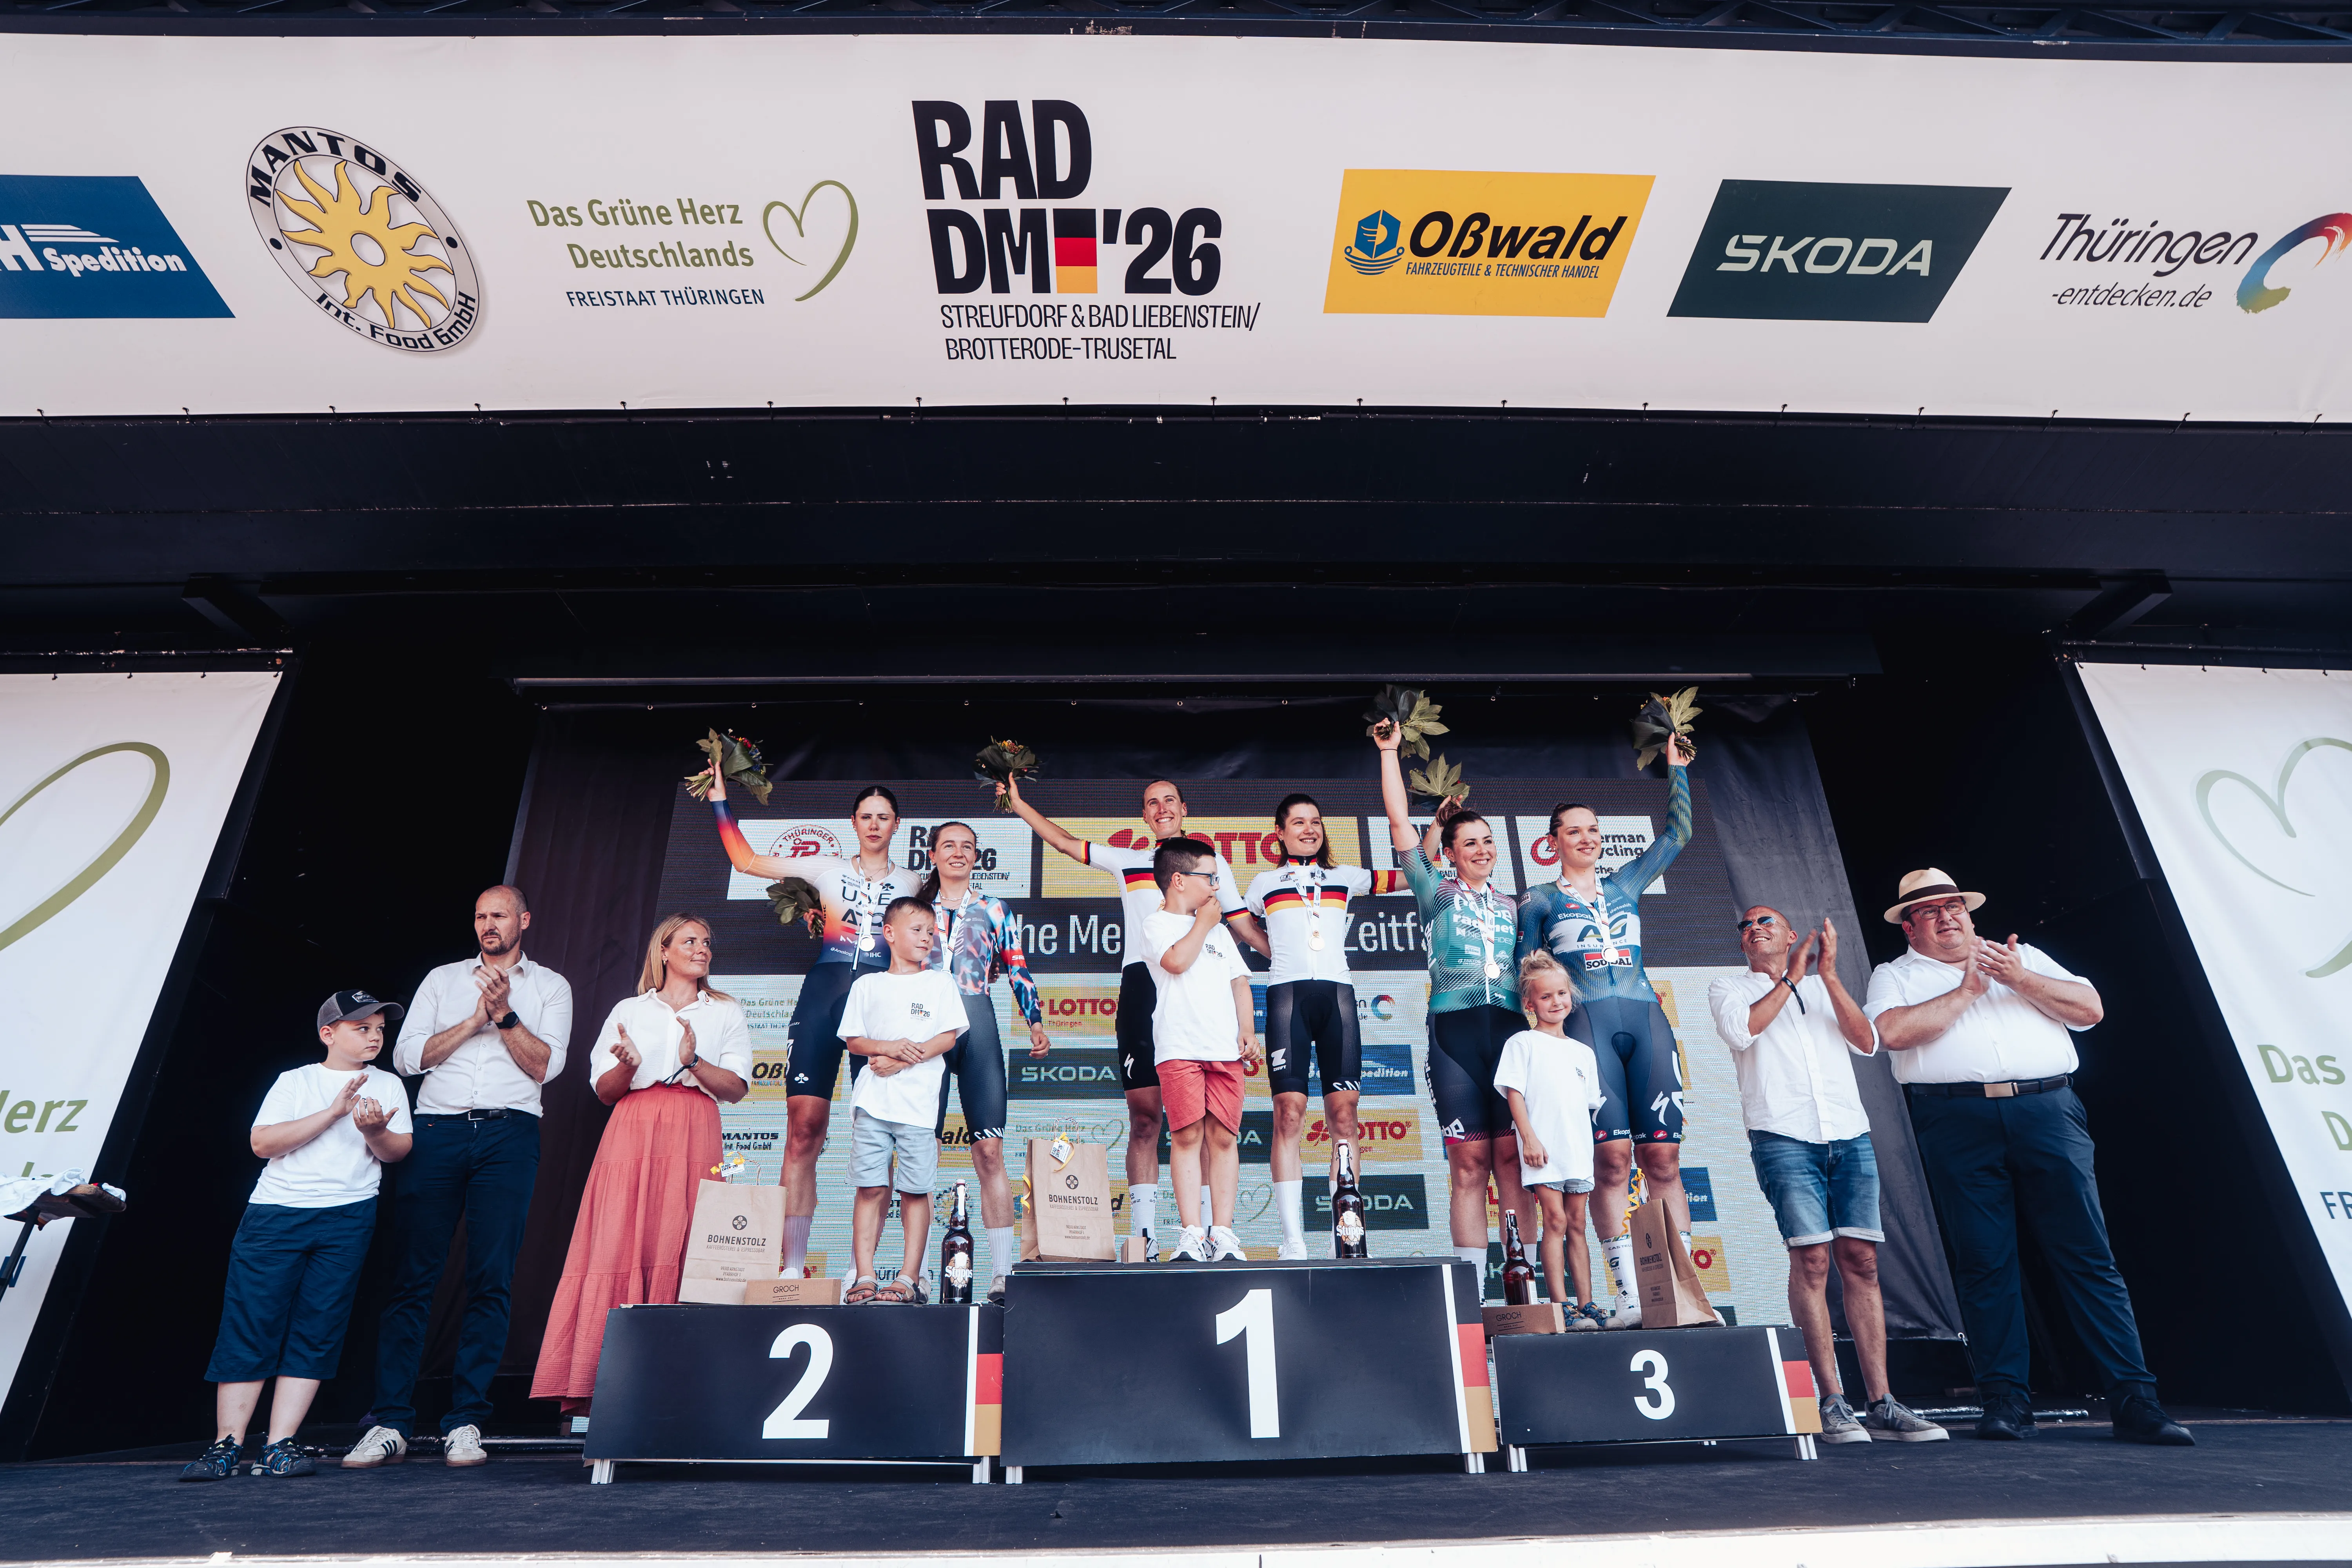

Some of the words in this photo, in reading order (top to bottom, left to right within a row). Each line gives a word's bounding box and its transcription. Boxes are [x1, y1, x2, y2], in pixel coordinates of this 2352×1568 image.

[911, 99, 1092, 200] RAD
[250, 131, 421, 207] MANTOS
[526, 200, 583, 227] Das
[587, 199, 672, 226] Grüne
[676, 198, 743, 225] Herz
[1409, 211, 1628, 261] Oßwald
[2040, 213, 2258, 277] Thüringen
[0, 225, 44, 270] H
[43, 246, 187, 277] Spedition
[566, 240, 754, 269] Deutschlands
[1406, 262, 1483, 276] FAHRZEUGTEILE
[1485, 264, 1492, 276] &
[1495, 264, 1560, 278] TECHNISCHER
[1561, 265, 1599, 279] HANDEL
[566, 290, 655, 307] FREISTAAT
[661, 287, 764, 305] THÜRINGEN
[2051, 282, 2212, 308] -entdecken.de
[316, 293, 361, 331] Int.
[370, 315, 434, 349] Food
[434, 291, 476, 347] GmbH
[940, 304, 1067, 328] STREUFDORF
[1072, 305, 1084, 328] &
[1089, 304, 1128, 327] BAD
[945, 337, 1176, 360] BROTTERODE-TRUSETAL
[1601, 834, 1646, 843] erman
[1601, 844, 1645, 859] ycling
[842, 886, 891, 906] UE
[1069, 915, 1120, 954] Me
[1344, 912, 1426, 951] Zeitf
[1577, 939, 1628, 948] INSURNCE
[834, 948, 853, 956] Analog
[1049, 999, 1116, 1016] LOTTO
[1022, 1067, 1116, 1081] SKODA
[2257, 1045, 2345, 1085] Das
[0, 1090, 88, 1133] erz
[1049, 1194, 1098, 1205] BOHNENSTOLZ
[708, 1234, 766, 1247] BOHNENSTOLZ
[1336, 1225, 1364, 1238] Stupps
[1639, 1253, 1662, 1266] BOHNENSTOLZ
[773, 1285, 799, 1293] GROCH
[1496, 1311, 1521, 1321] GROCH
[1216, 1289, 1279, 1438] 1
[762, 1324, 833, 1439] 2
[1630, 1350, 1675, 1419] 3
